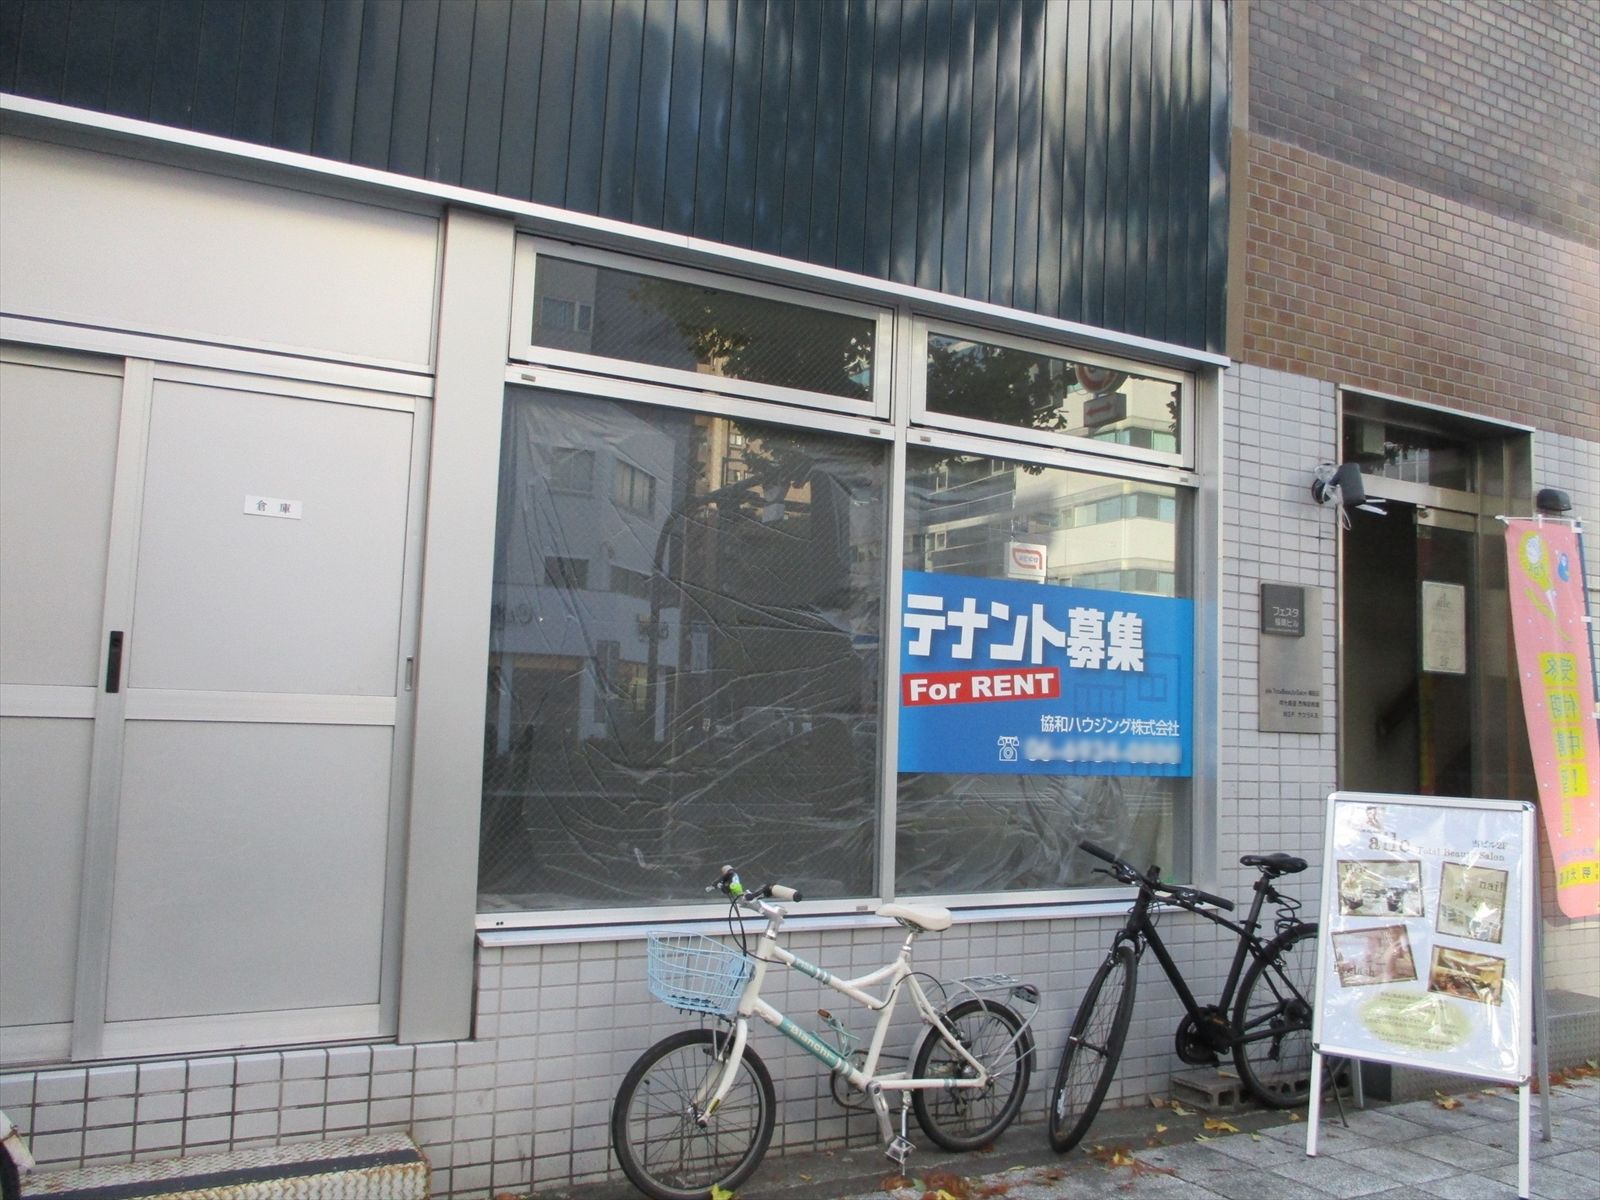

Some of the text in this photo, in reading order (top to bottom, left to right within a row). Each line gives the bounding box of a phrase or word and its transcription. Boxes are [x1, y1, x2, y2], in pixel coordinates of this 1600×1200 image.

[256, 499, 291, 514] 倉庫
[1272, 606, 1299, 618] フェスタ
[903, 594, 1145, 673] テナント募集
[909, 673, 1055, 702] For RENT
[1040, 714, 1180, 737] 協和ハウジング株式会社
[1443, 847, 1475, 860] Beau
[1479, 852, 1505, 862] Salon
